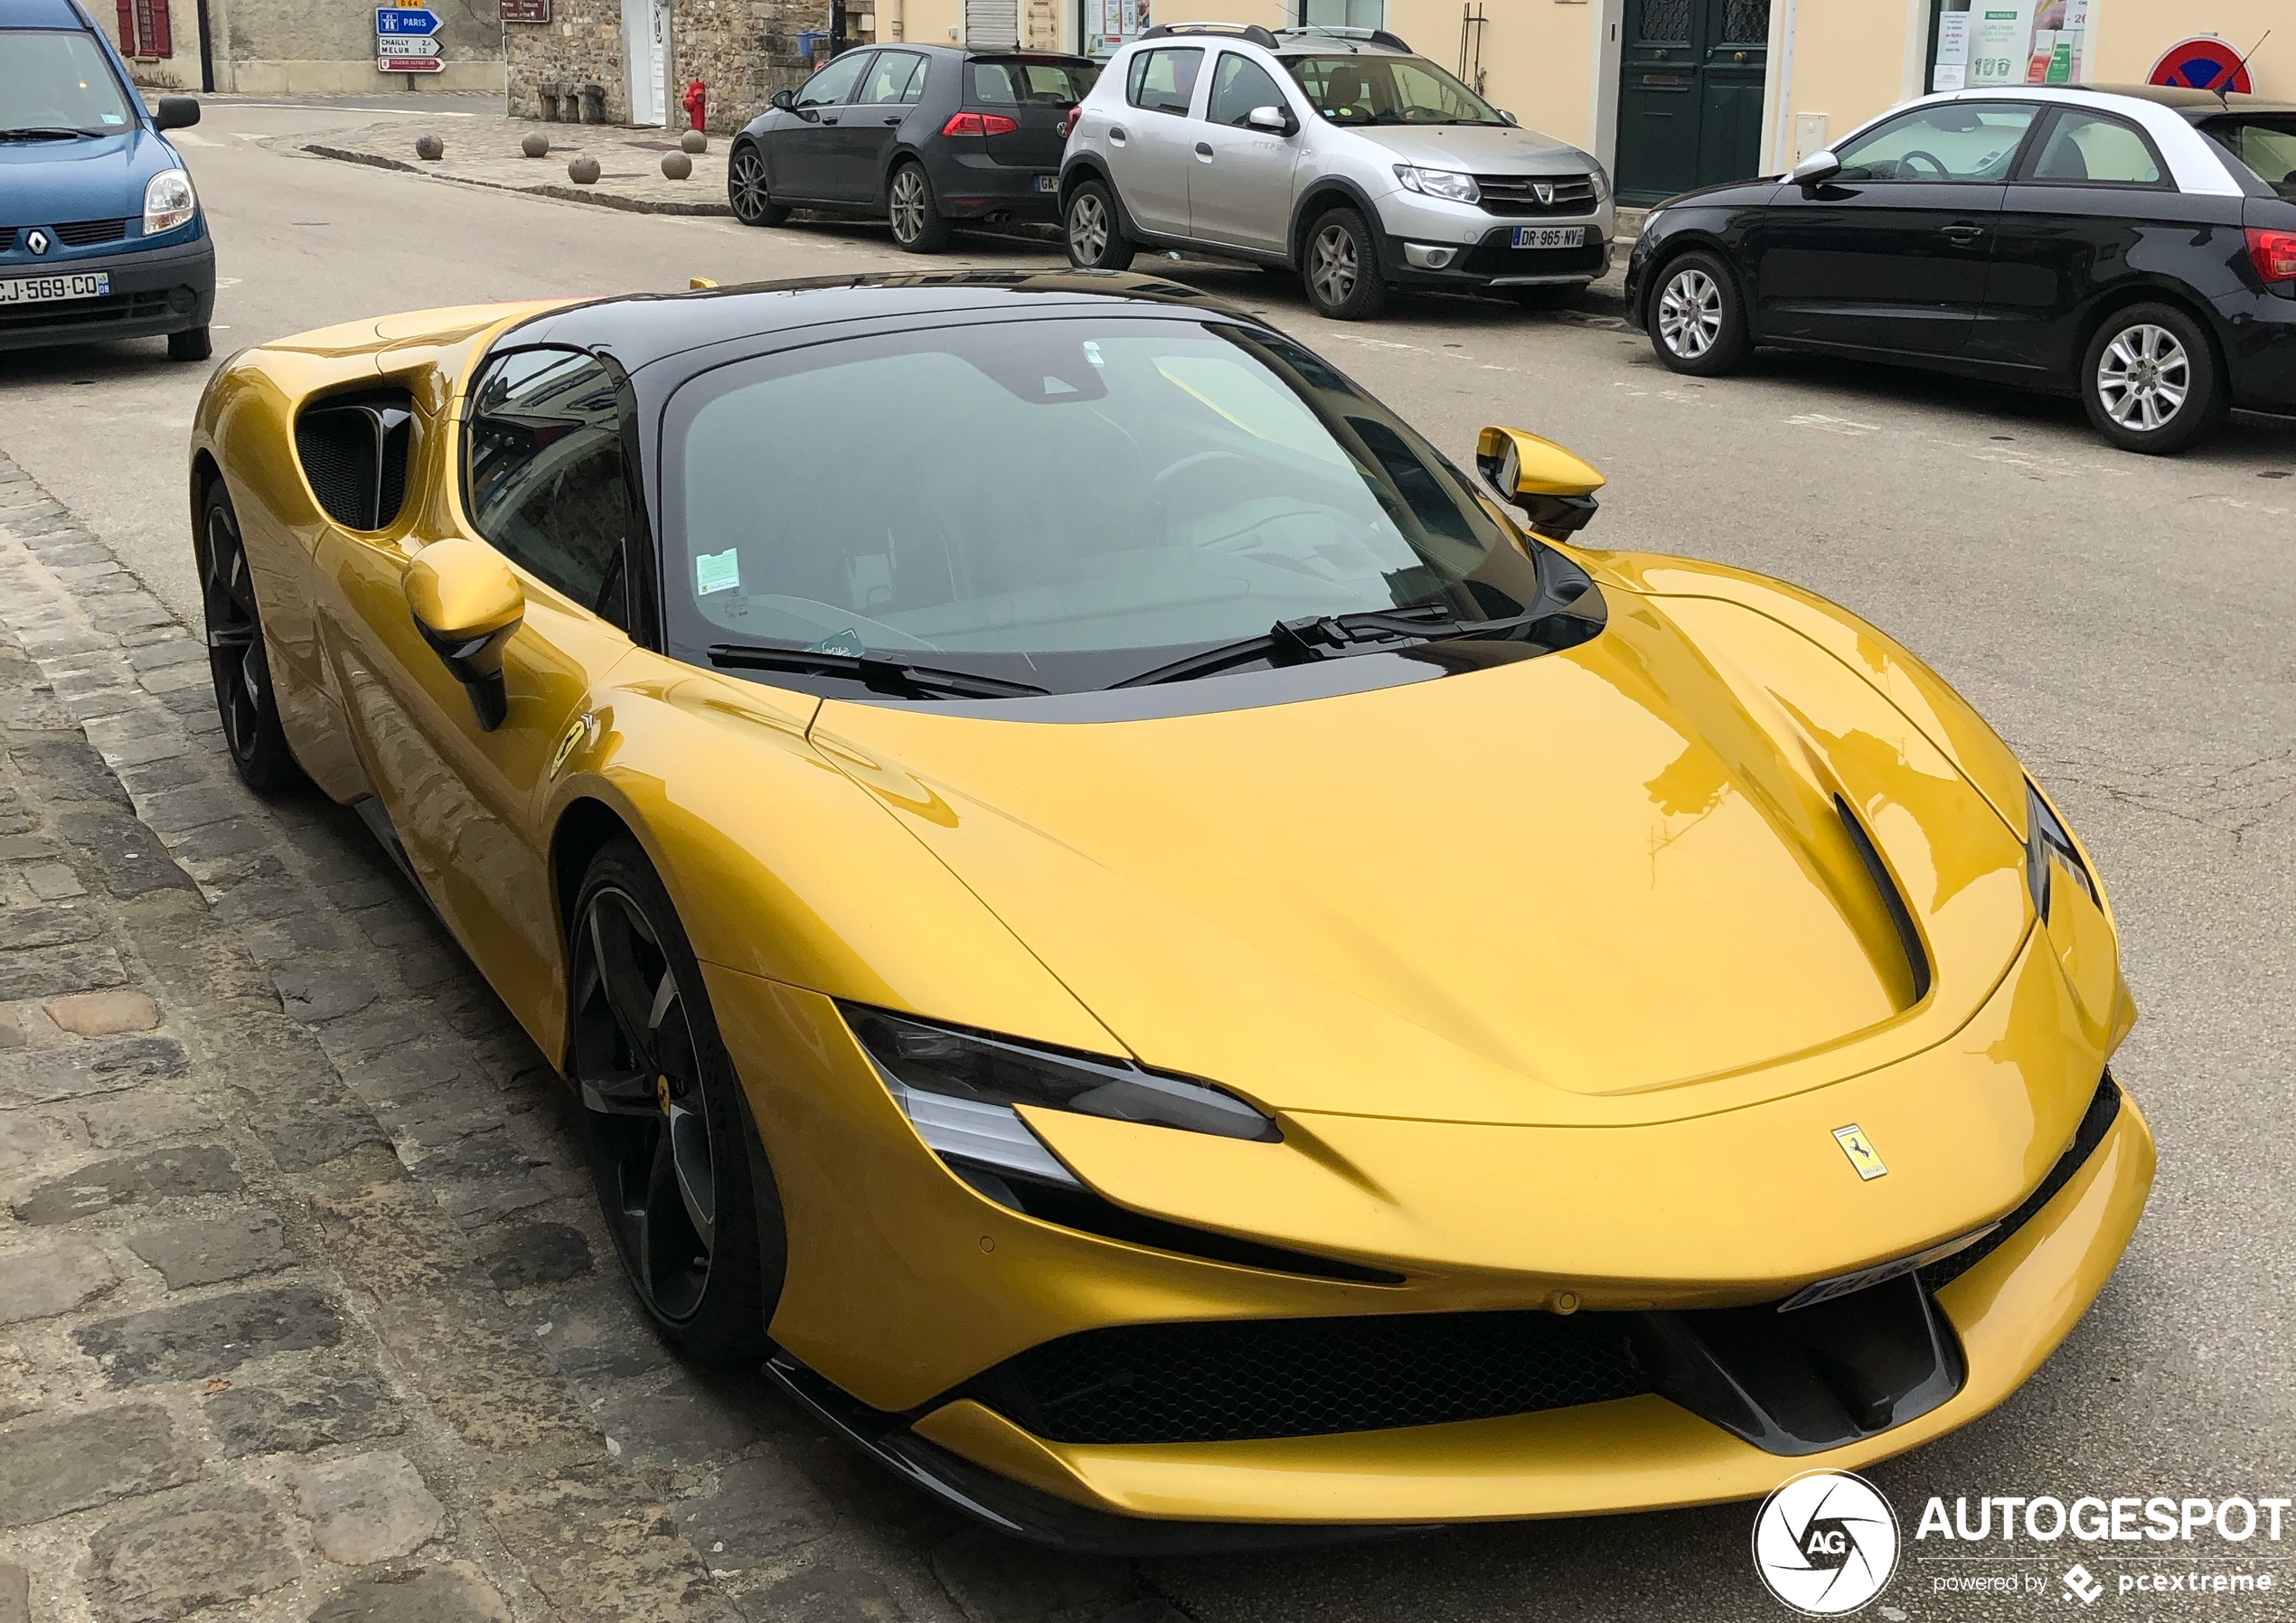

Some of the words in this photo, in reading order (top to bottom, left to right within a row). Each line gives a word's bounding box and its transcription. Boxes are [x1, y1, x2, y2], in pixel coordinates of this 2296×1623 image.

[403, 18, 427, 27] PARIS
[1041, 177, 1059, 190] GA-
[1520, 230, 1577, 246] DR-965-NV
[99, 285, 109, 294] 08
